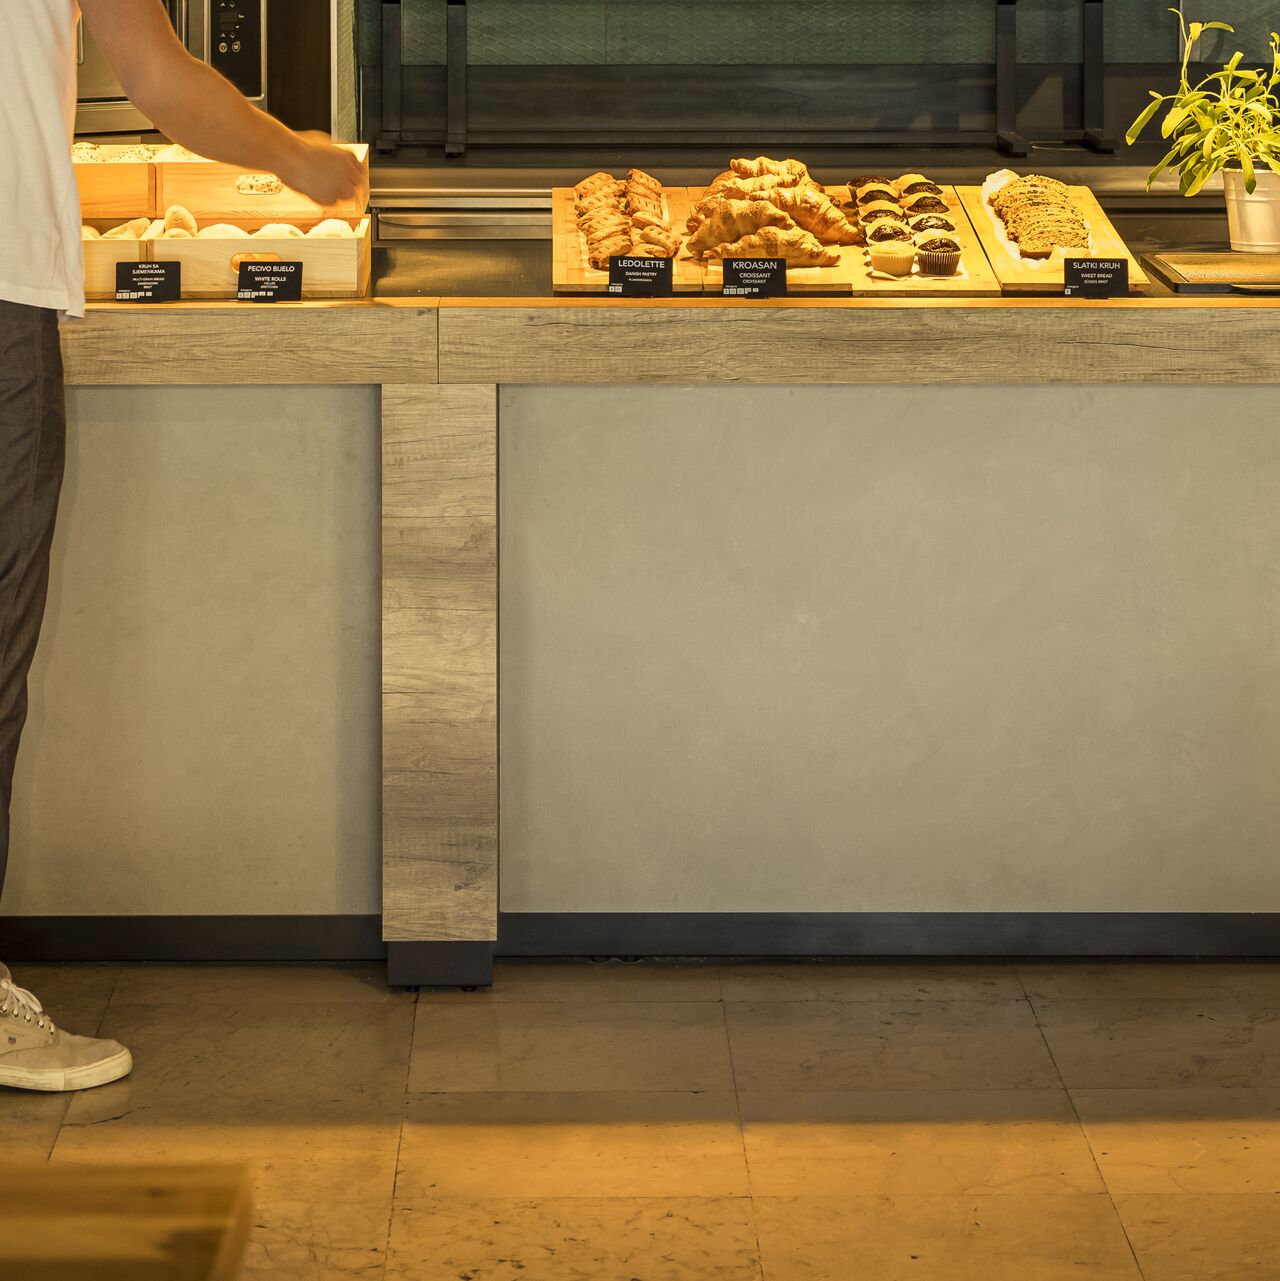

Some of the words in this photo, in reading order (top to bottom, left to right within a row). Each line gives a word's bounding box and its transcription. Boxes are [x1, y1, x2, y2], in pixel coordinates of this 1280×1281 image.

[618, 260, 665, 269] LEDOLETTE
[732, 261, 777, 270] KROASAN
[1073, 261, 1098, 269] SLATKI
